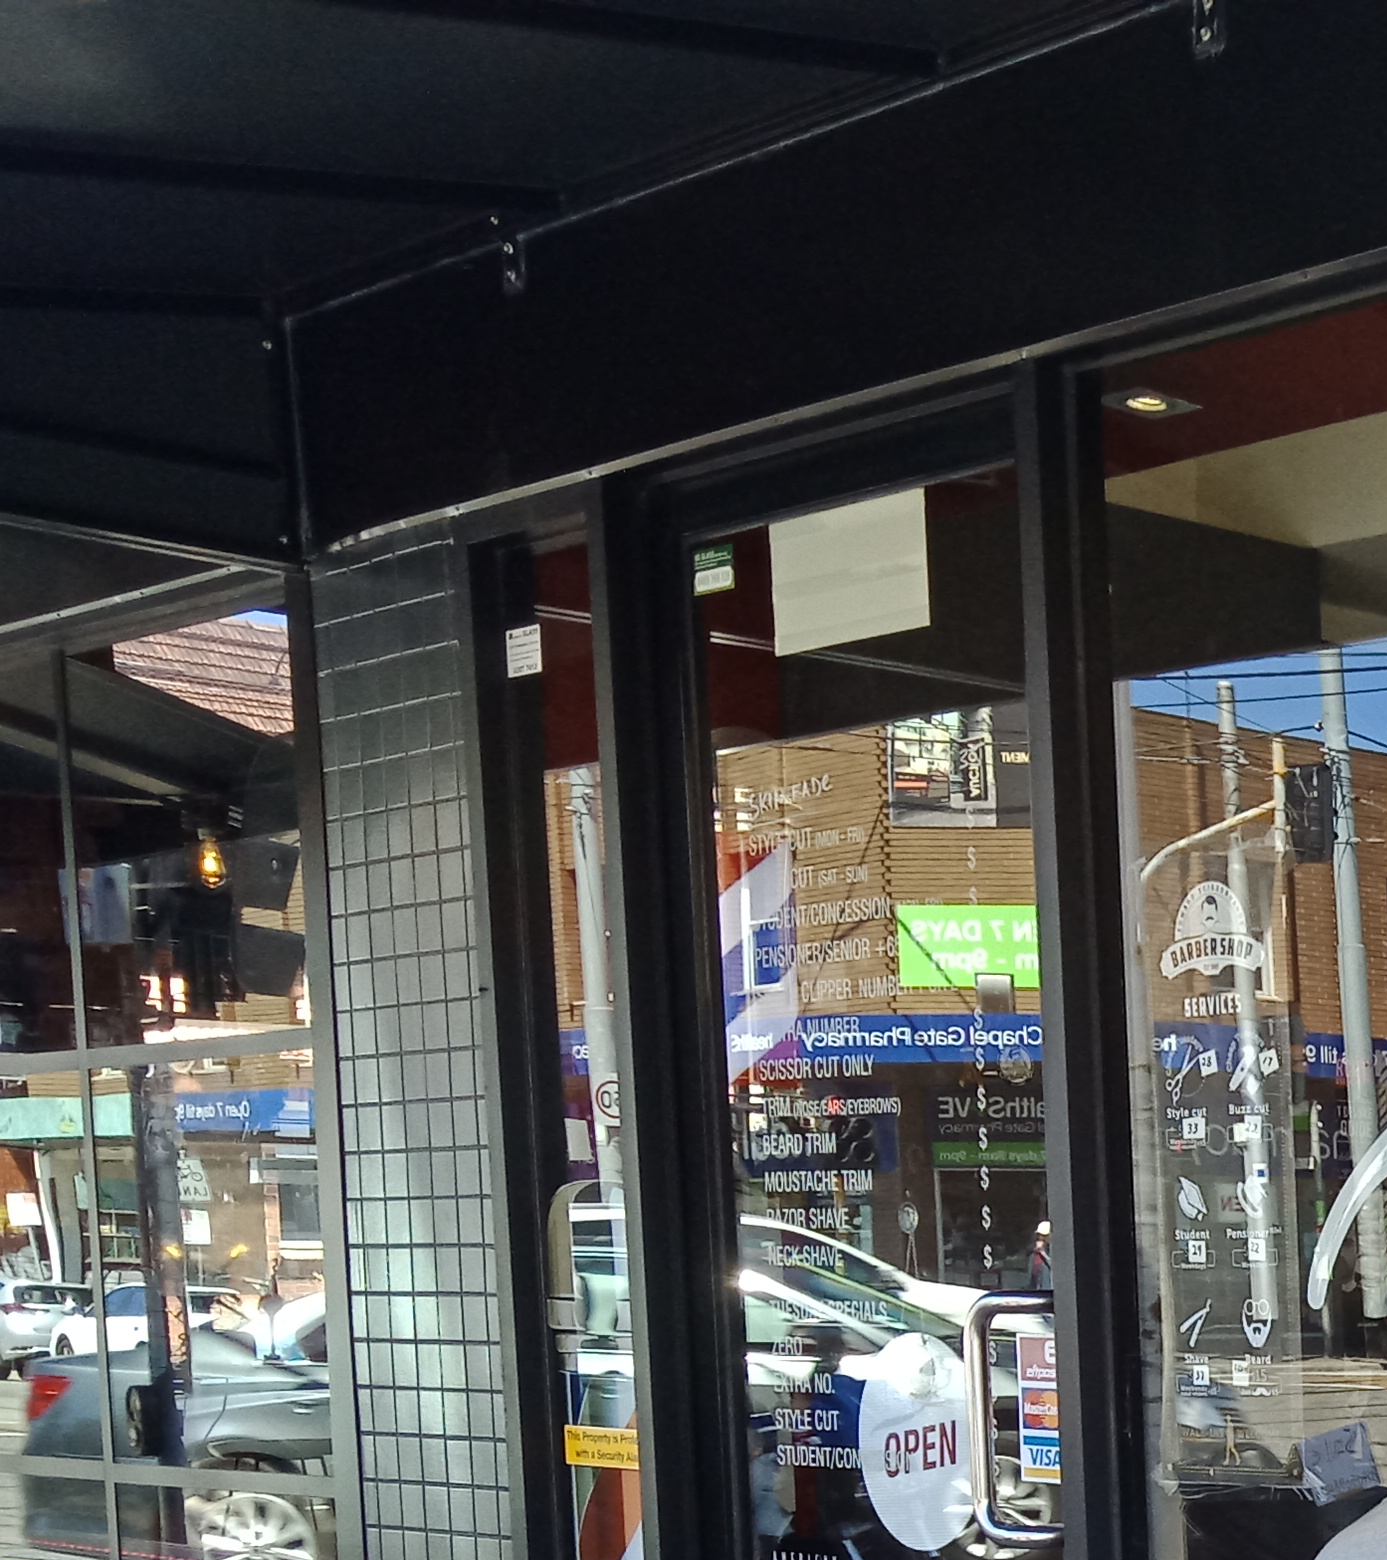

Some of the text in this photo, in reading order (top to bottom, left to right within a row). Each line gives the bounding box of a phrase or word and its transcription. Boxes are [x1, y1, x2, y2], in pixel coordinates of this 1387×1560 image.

[788, 827, 812, 851] CUT
[791, 866, 813, 889] CUT
[755, 896, 890, 933] TUDENT/CONCESSION
[755, 937, 871, 969] PENSIONER/SENIOR
[801, 977, 852, 1004] CLIPPER
[1184, 993, 1243, 1018] SERVICES
[760, 1056, 812, 1082] SCISSOR
[814, 1056, 840, 1079] CUT
[843, 1054, 875, 1077] ONLY
[1165, 1107, 1207, 1121] Style cut
[763, 1133, 803, 1156] BEARD
[805, 1132, 837, 1156] TRIM
[764, 1170, 839, 1193] MOUSTACHE
[841, 1169, 873, 1192] TRIM
[809, 1206, 851, 1231] SHAVE
[1174, 1228, 1211, 1240] Student
[1226, 1228, 1270, 1240] Pensioner
[768, 1246, 801, 1267] NECK
[802, 1245, 844, 1268] SHAVE
[774, 1408, 840, 1432] STYLE CUT
[582, 1430, 611, 1445] Property
[884, 1420, 957, 1478] OPEN
[597, 1449, 624, 1463] Security
[1029, 1447, 1060, 1467] VISA
